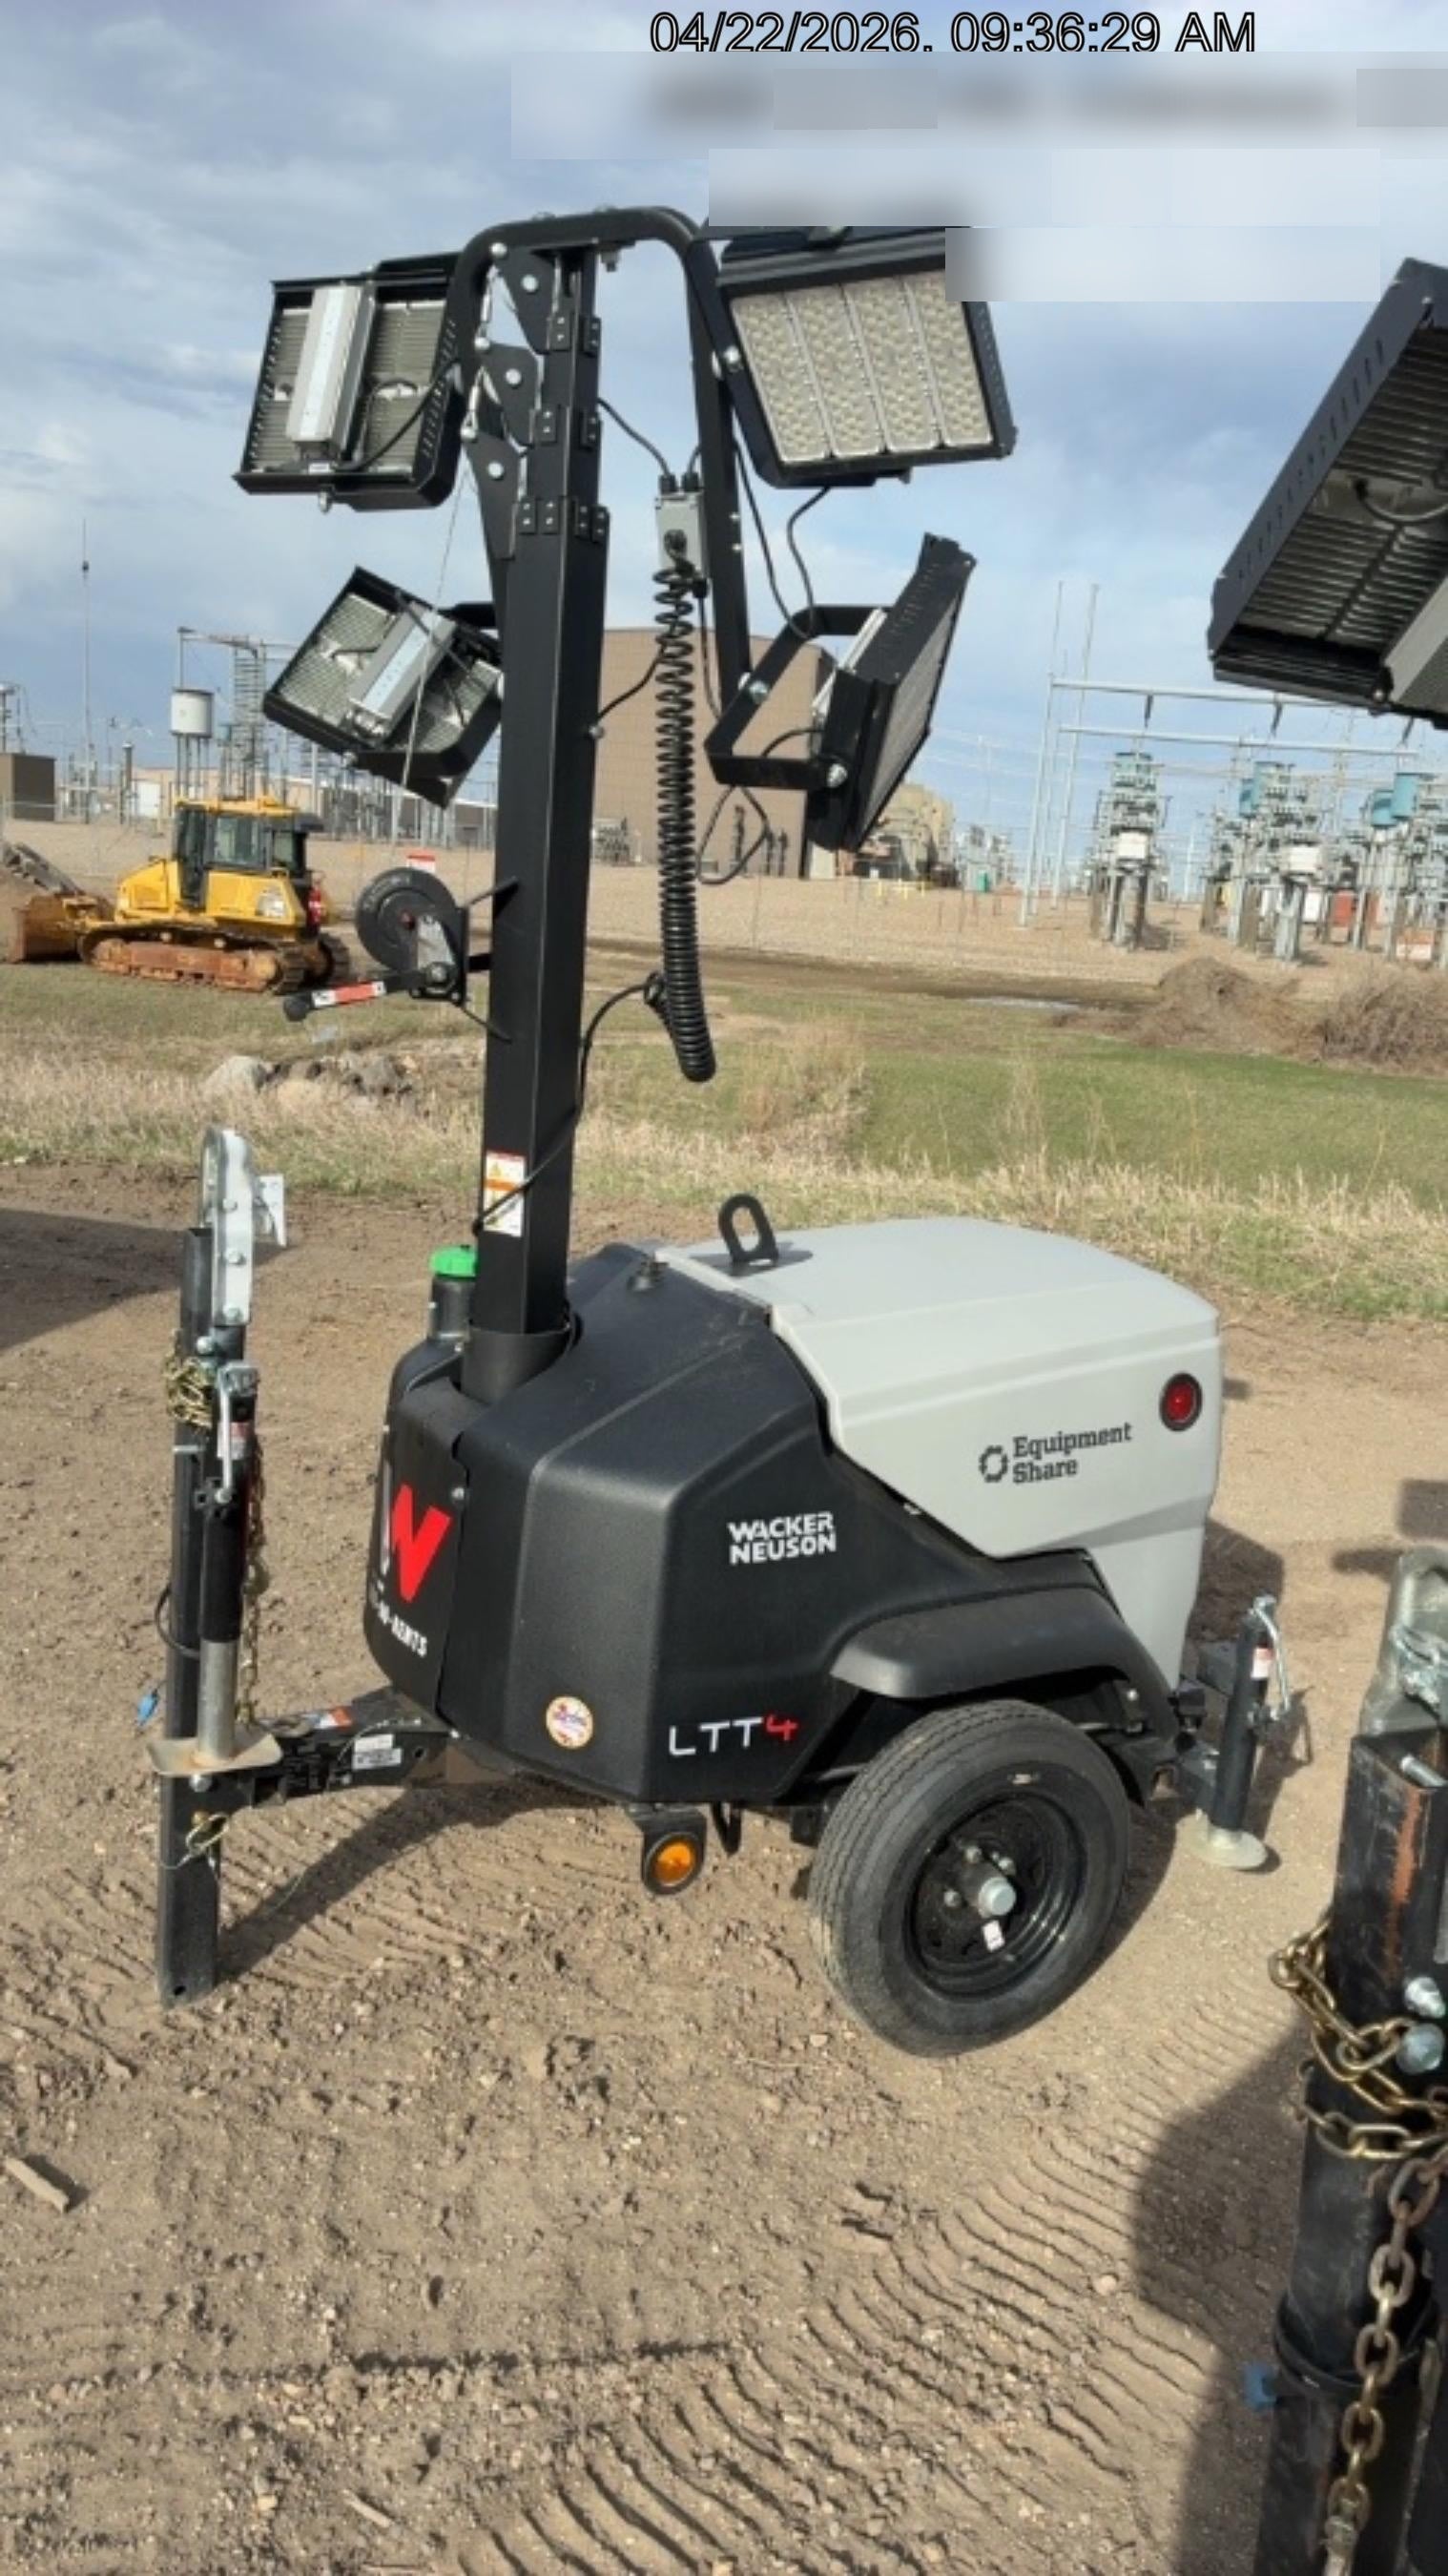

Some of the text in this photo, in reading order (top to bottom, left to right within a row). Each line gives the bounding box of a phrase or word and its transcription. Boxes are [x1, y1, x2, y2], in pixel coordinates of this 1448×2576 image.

[1012, 1422, 1133, 1461] Equipment
[1012, 1459, 1079, 1484] Share
[727, 1510, 835, 1544] WACKER
[729, 1531, 838, 1565] NEUSON
[669, 1714, 798, 1757] LTT4
